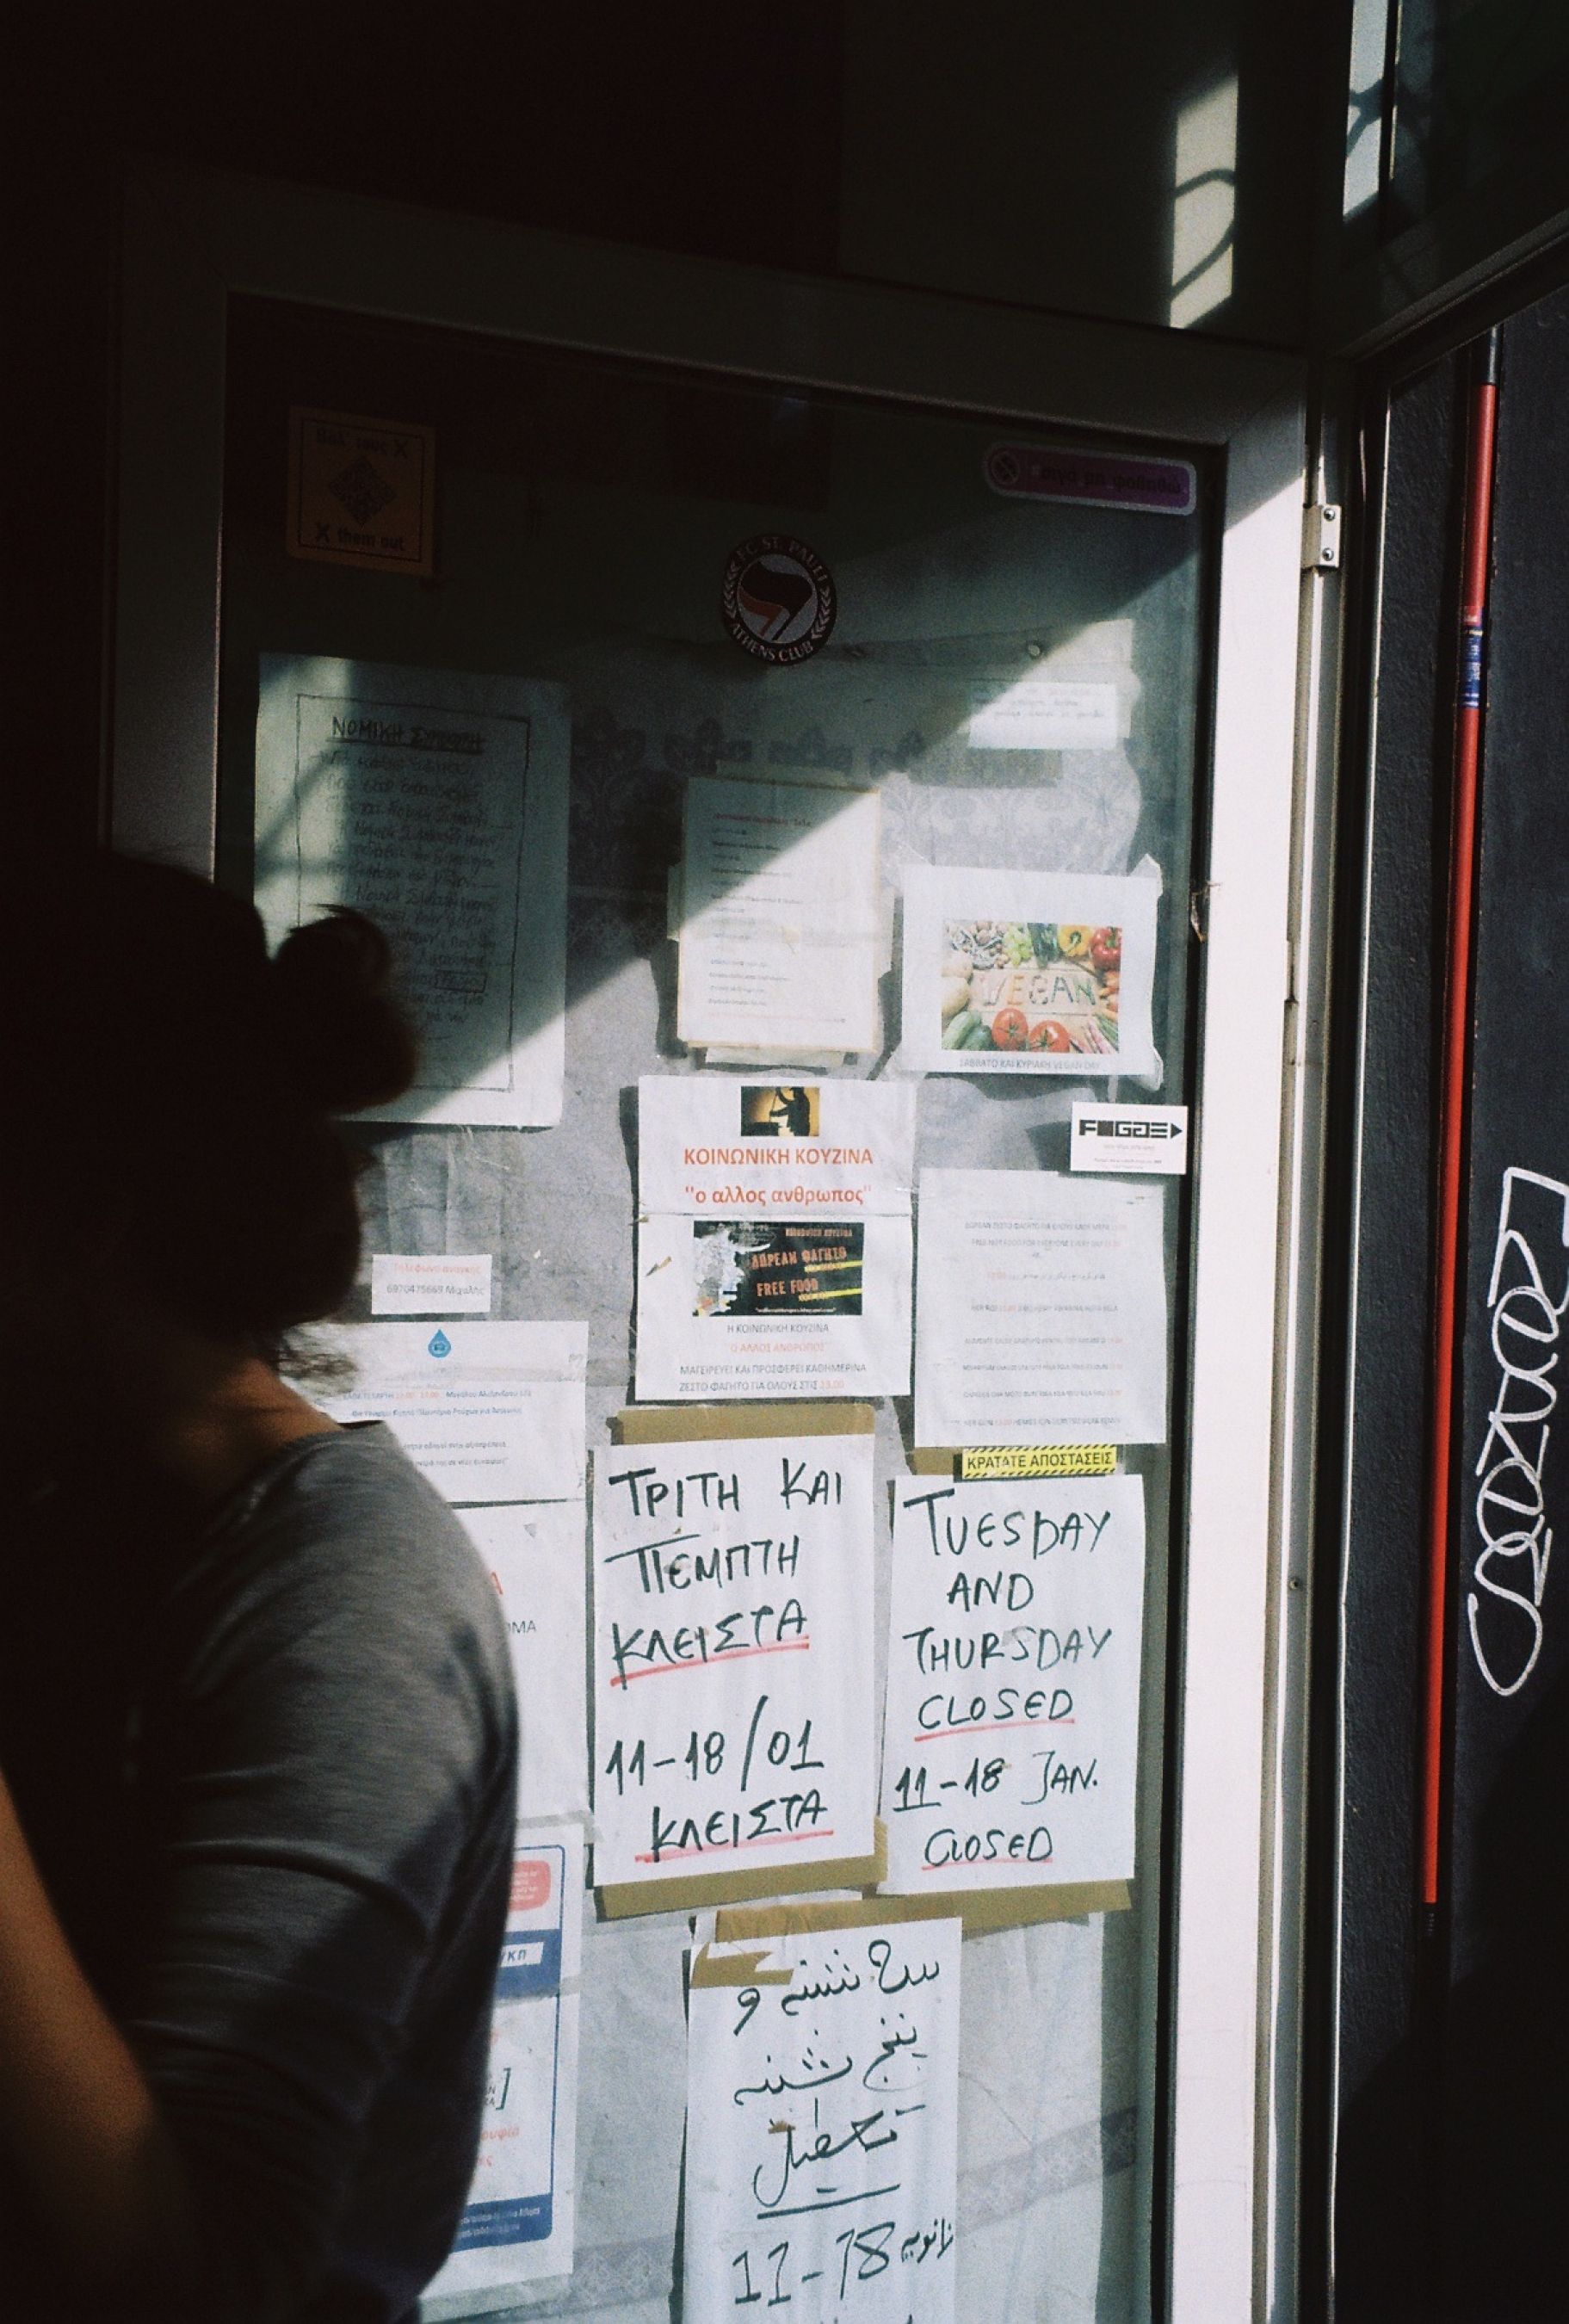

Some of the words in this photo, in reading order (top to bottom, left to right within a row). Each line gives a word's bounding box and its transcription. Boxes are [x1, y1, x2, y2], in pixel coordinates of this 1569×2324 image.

[338, 527, 374, 547] them
[381, 537, 404, 551] out
[778, 640, 813, 662] CLUB
[980, 975, 1096, 1005] VEGAN
[684, 1147, 790, 1165] ΚΟΙΝΩΝΙΚΗ
[795, 1147, 874, 1165] ΚΟΥΖΙΝΑ
[712, 1186, 766, 1206] αλλος
[751, 1251, 797, 1270] ΔΩΡΕΑΝ
[801, 1246, 847, 1264] ΦΑΓΗΤΟ
[757, 1281, 786, 1296] FREE
[790, 1278, 818, 1294] FOOD
[736, 1324, 788, 1333] ΚΟΙΝΩΝΙΚΗ
[790, 1324, 829, 1333] ΚΟΥΖΙΝΑ
[680, 1365, 733, 1375] ΜΑΓΕΙΡΕΥΕΙ
[806, 1363, 866, 1374] ΚΑΘΗΜΕΡΙΝΑ
[680, 1382, 708, 1392] ΖΕΣΤΟ
[967, 1455, 1027, 1470] ΚΡΑΤΑΤΕ
[1029, 1452, 1113, 1468] ΑΠΟΣΤΑΣΕΙΣ
[609, 1467, 739, 1517] ΤΡΙΤΗ
[781, 1457, 842, 1510] ΚΑΙ
[904, 1488, 1111, 1559] TUESDAY
[605, 1533, 800, 1593] ΠΕΜΠΤΗ
[947, 1572, 1034, 1612] AND
[612, 1598, 806, 1690] ΚΛΕΙΣΤΑ
[902, 1626, 1112, 1675] THURSDAY
[917, 1689, 1073, 1729] CLOSED
[1021, 1751, 1098, 1805] JAN.
[652, 1788, 827, 1863] ΚΛΕΙΣΤΑ
[924, 1826, 1053, 1867] CLOSED
